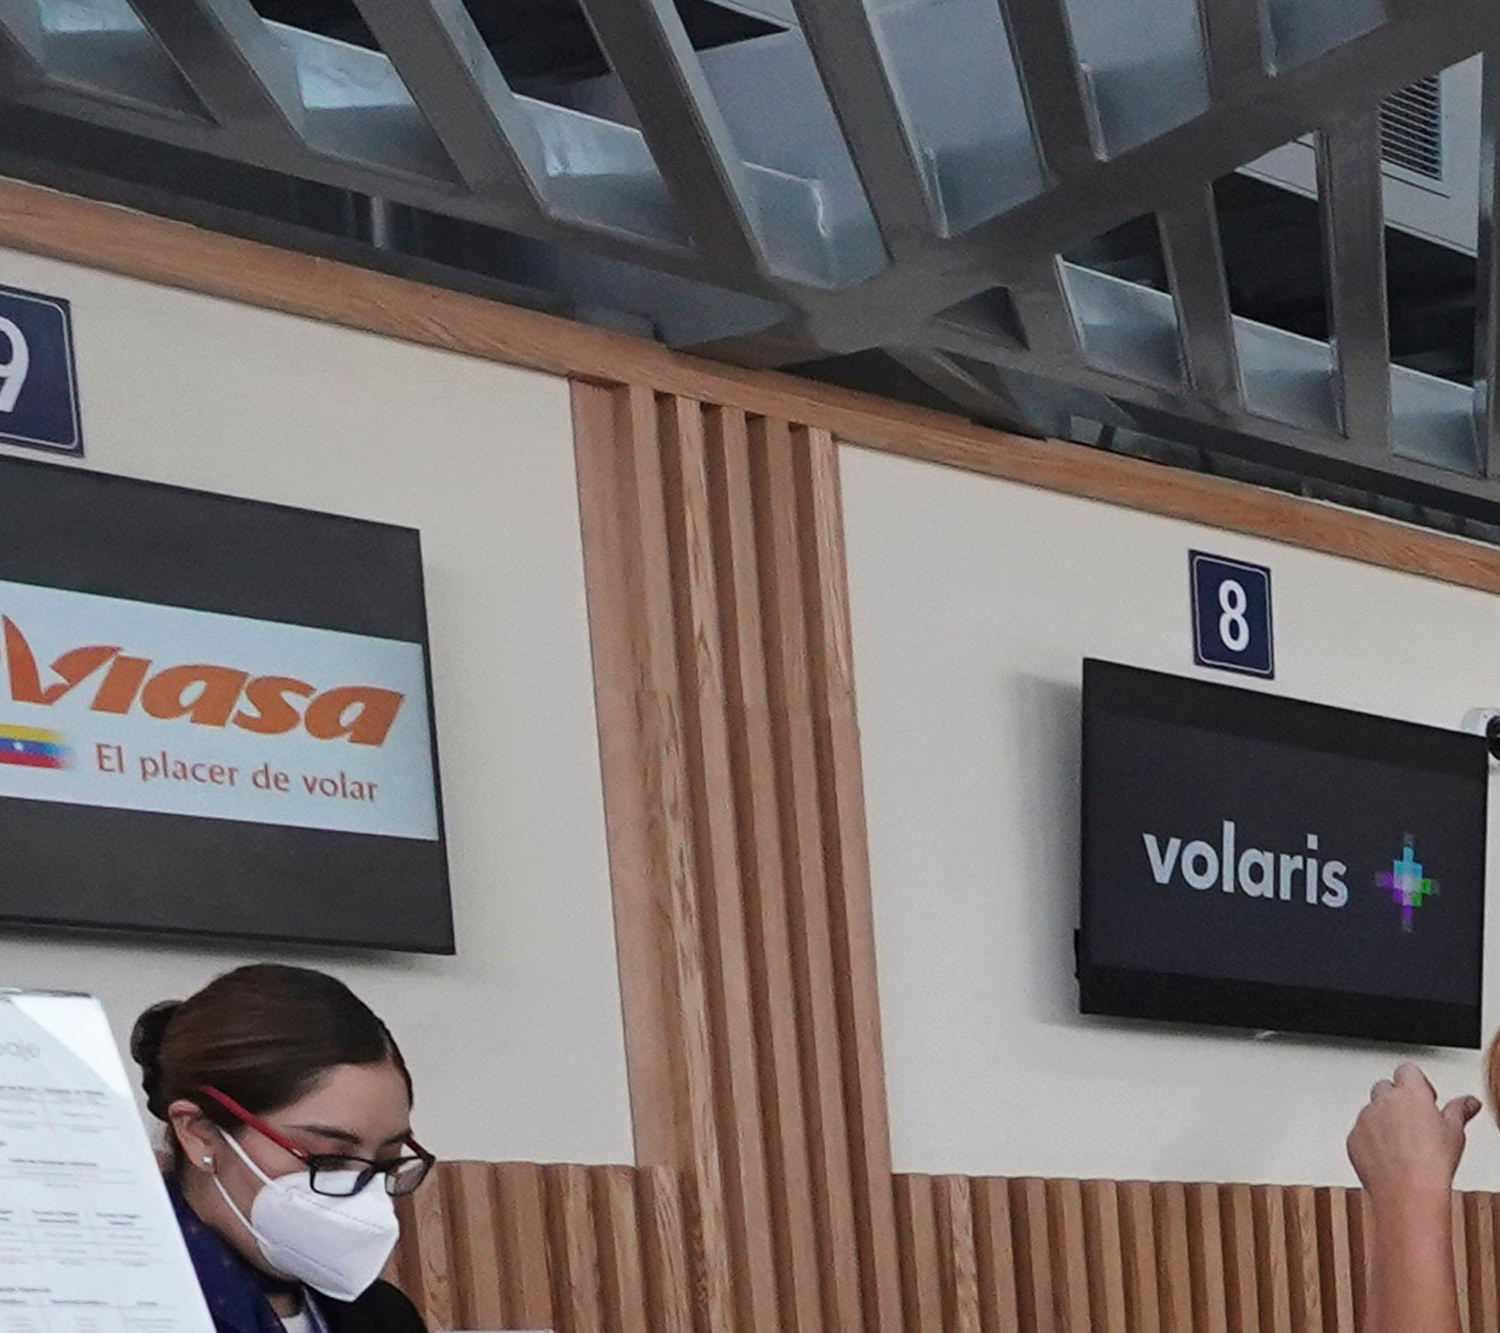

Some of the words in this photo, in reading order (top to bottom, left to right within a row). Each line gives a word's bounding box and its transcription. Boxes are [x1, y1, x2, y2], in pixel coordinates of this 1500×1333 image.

[1218, 579, 1250, 652] 8
[96, 744, 127, 775] El
[140, 752, 239, 788] placer
[251, 763, 291, 793] de
[303, 771, 380, 803] volar
[1143, 820, 1349, 909] volaris
